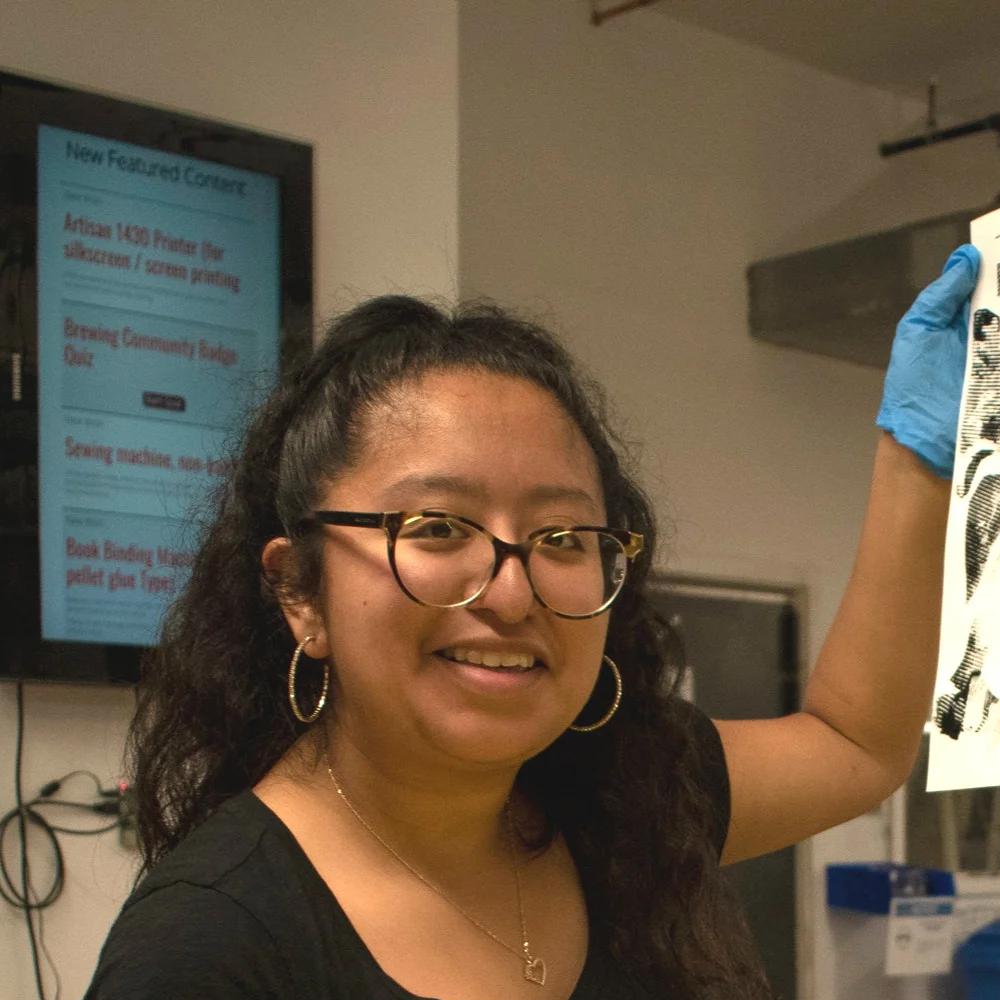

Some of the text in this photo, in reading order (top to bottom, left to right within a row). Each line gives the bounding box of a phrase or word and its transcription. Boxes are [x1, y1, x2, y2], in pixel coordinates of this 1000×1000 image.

[65, 141, 248, 196] New Featured Content
[63, 212, 112, 240] Artisan
[153, 229, 197, 255] Printer
[63, 240, 131, 270] silkscreen
[145, 258, 189, 282] screen
[63, 317, 238, 366] Brewing Community Badge
[63, 344, 94, 368] Quiz
[65, 435, 113, 466] Sewing
[66, 536, 99, 559] Book
[103, 540, 153, 567] Binding
[108, 568, 136, 592] glue
